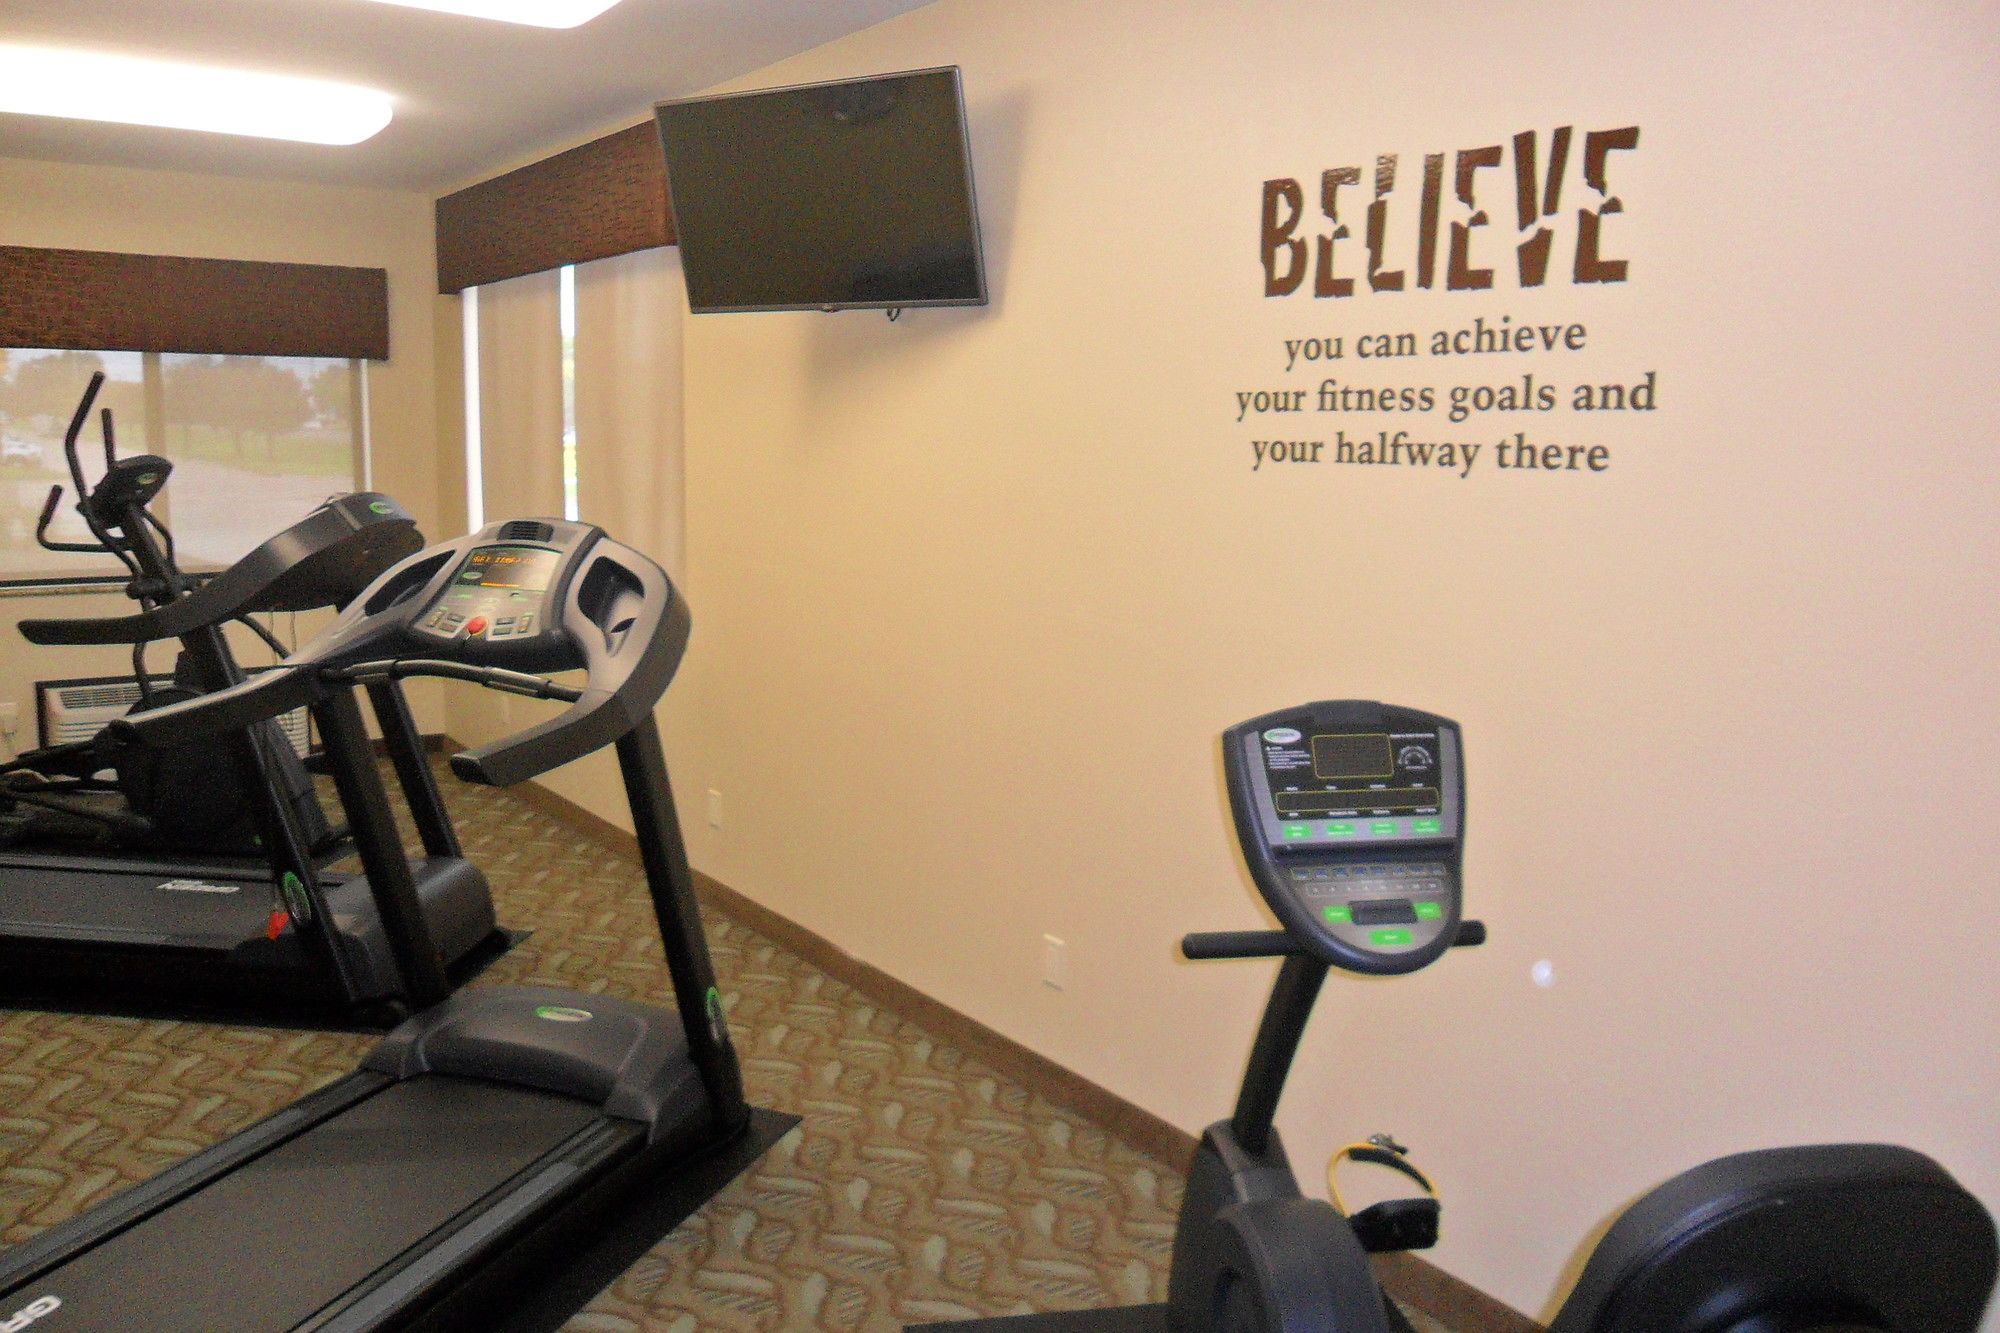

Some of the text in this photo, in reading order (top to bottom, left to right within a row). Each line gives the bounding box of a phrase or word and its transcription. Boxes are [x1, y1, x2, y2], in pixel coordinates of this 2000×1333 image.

[1259, 125, 1641, 299] BELIEVE
[1284, 315, 1587, 373] you can achieve
[1235, 370, 1657, 424] your fitness goals and
[1251, 430, 1610, 479] your halfway there
